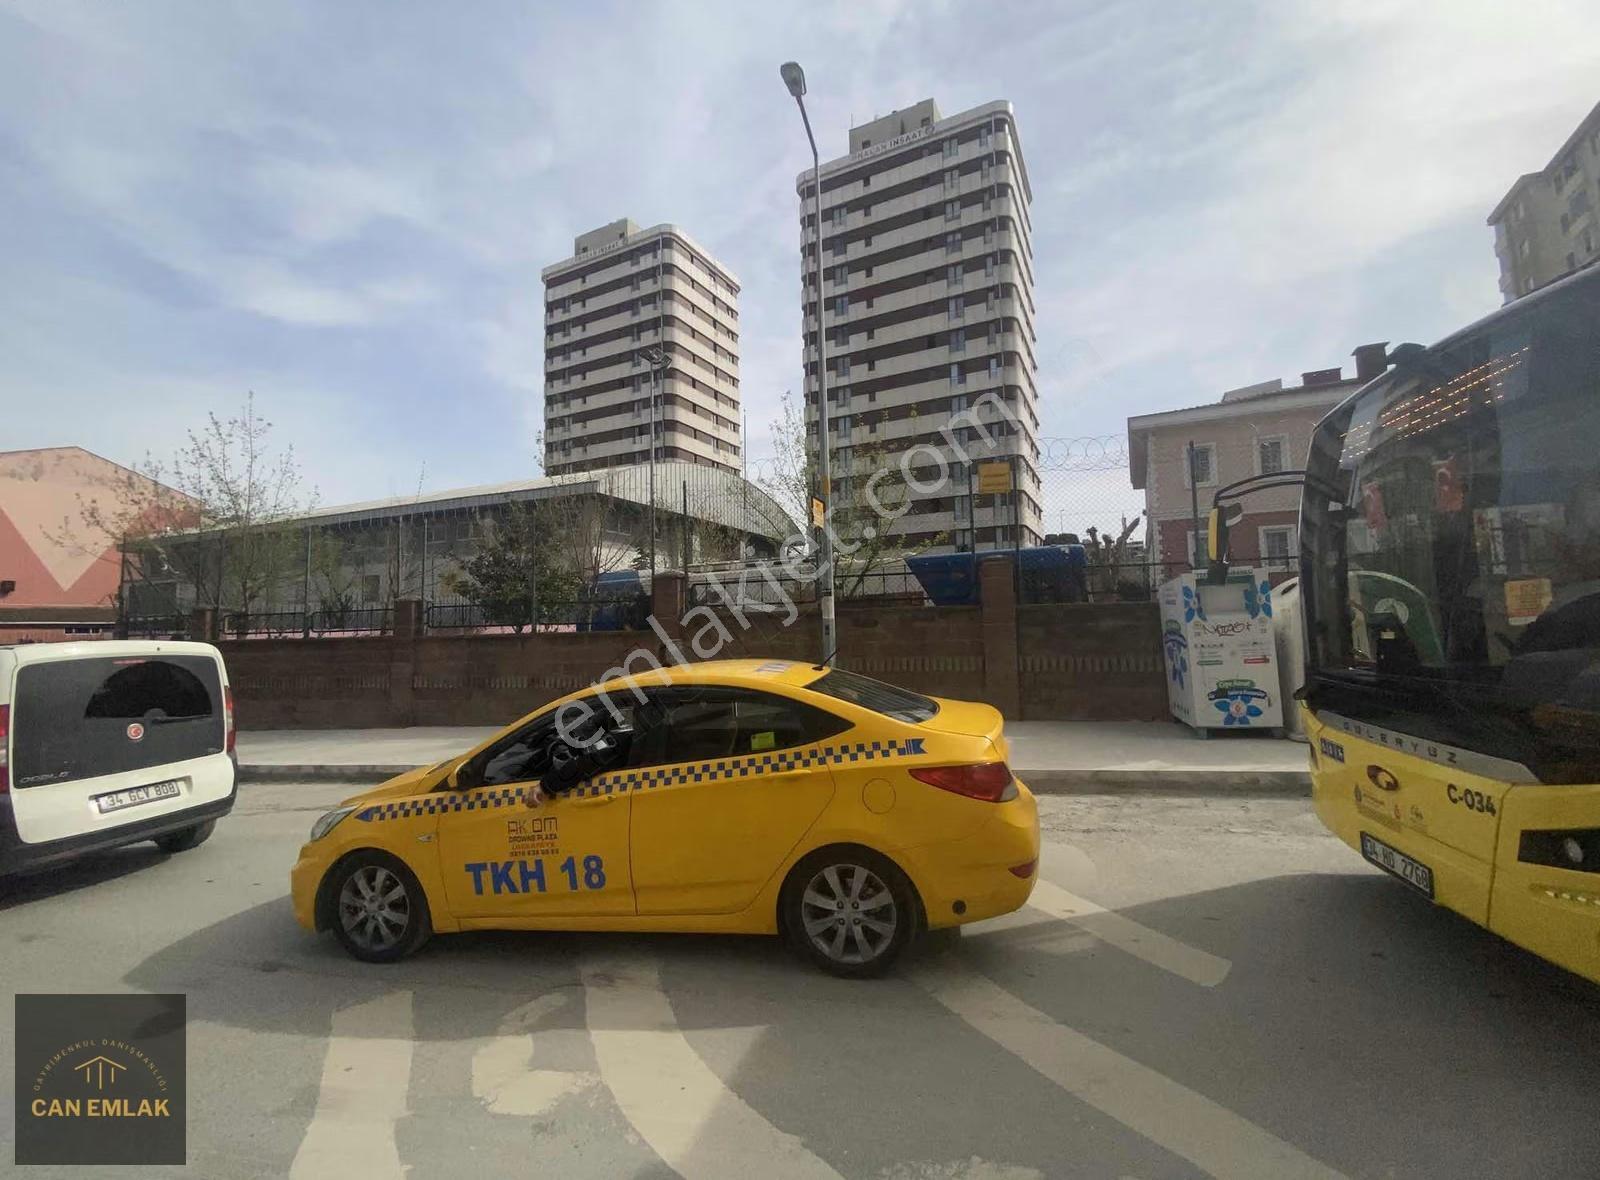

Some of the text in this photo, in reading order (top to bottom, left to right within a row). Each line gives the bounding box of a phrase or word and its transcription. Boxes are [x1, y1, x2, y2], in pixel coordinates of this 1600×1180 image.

[107, 795, 123, 806] 34
[1447, 783, 1497, 817] C-034
[465, 855, 606, 896] TKH 18
